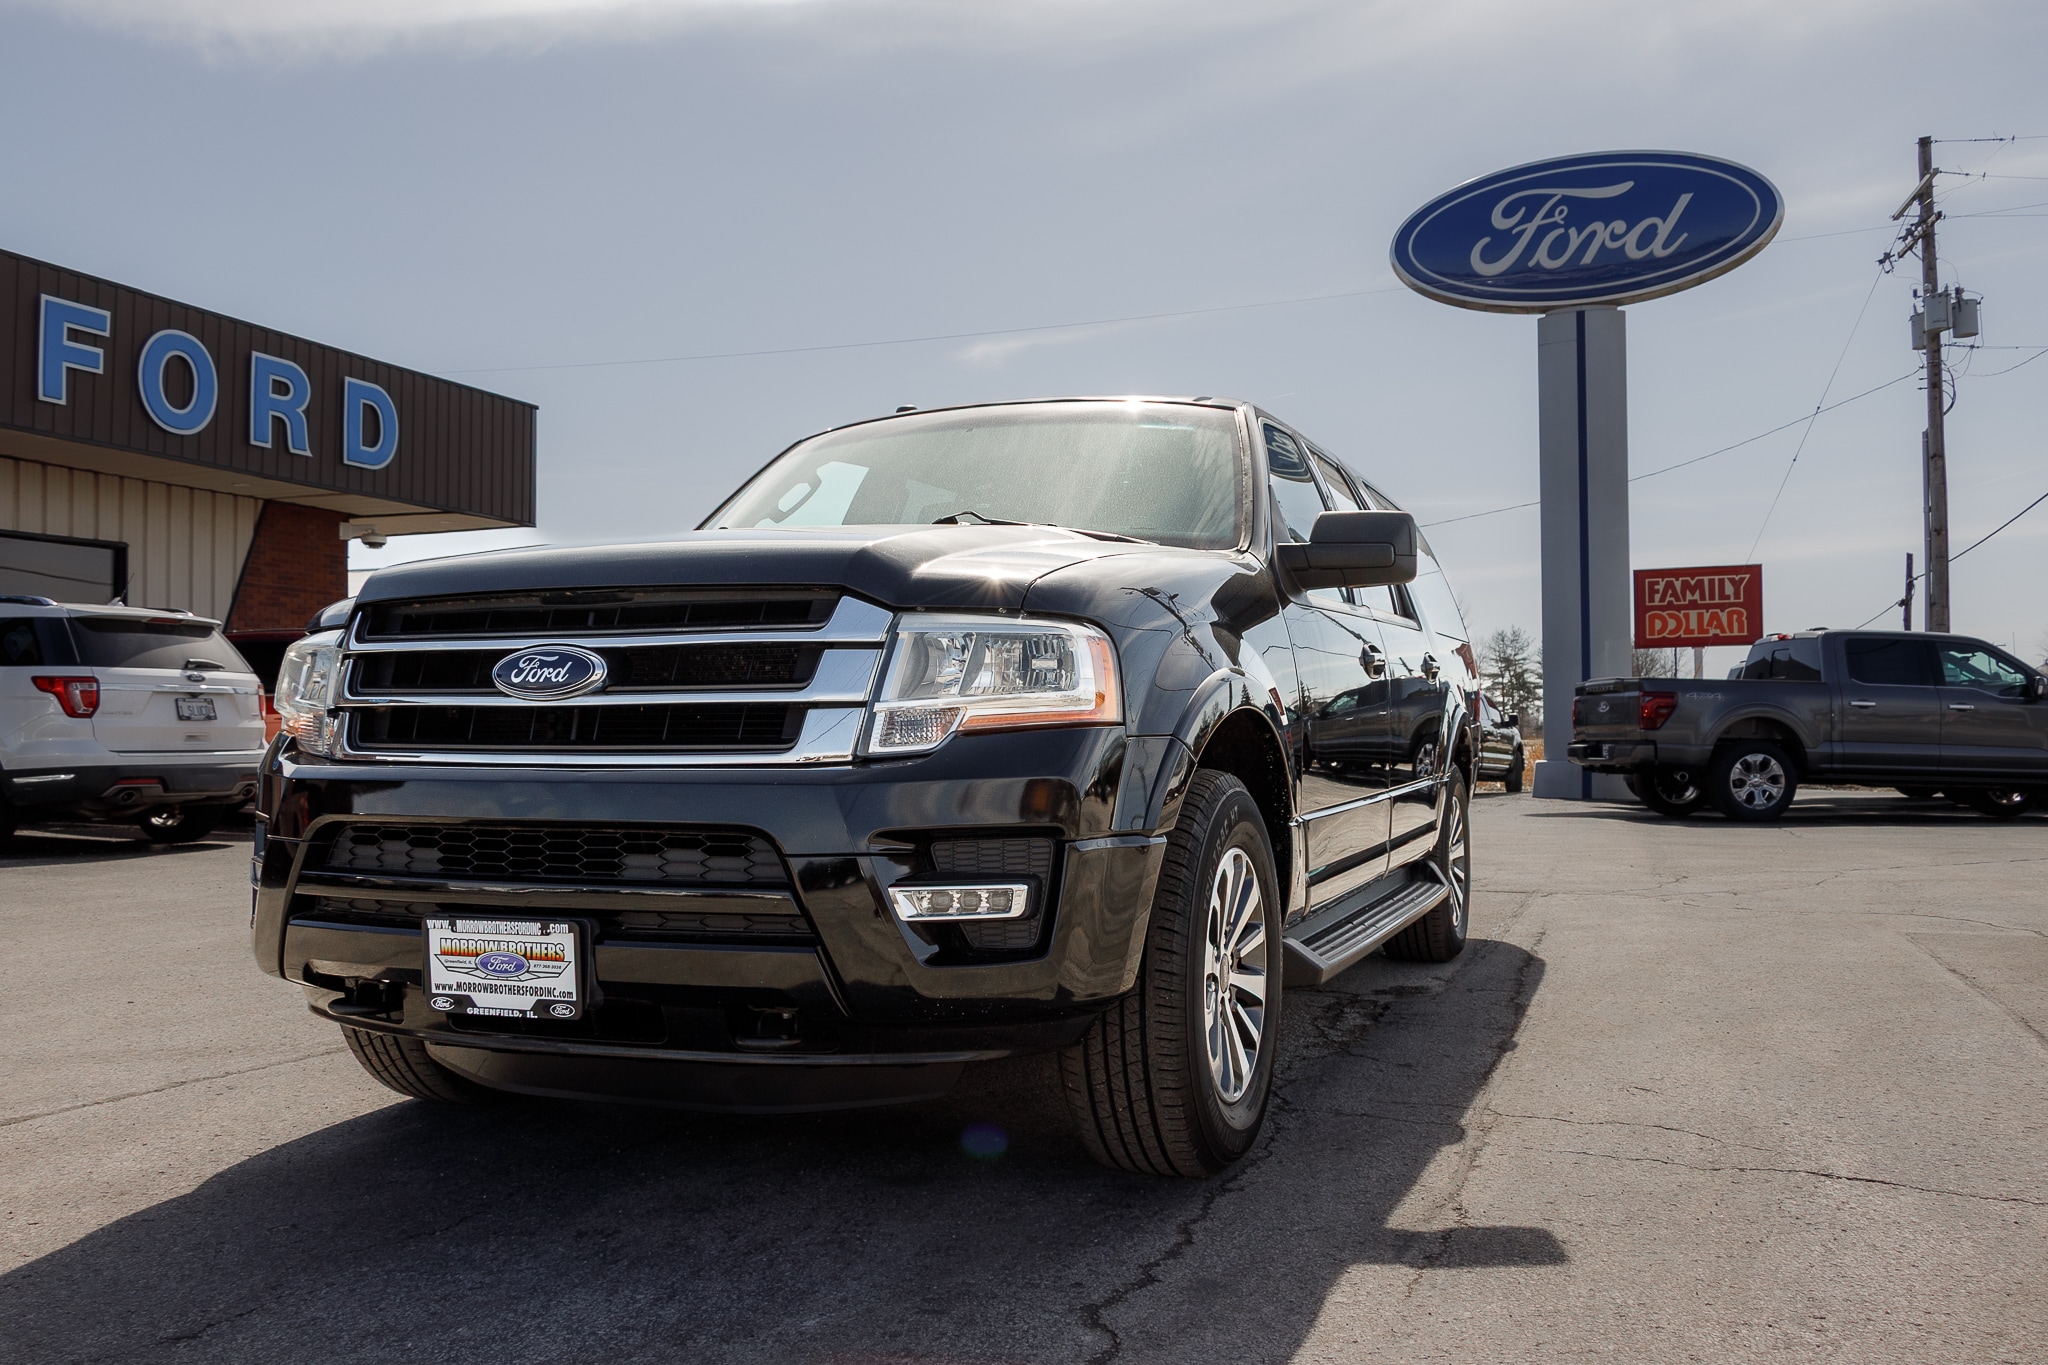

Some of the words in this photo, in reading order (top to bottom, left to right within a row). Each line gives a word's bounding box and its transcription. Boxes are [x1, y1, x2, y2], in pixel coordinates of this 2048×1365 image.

[1470, 180, 1694, 277] Ford
[38, 293, 400, 470] FORD
[1645, 574, 1751, 606] FAMILY
[1645, 607, 1748, 639] DOLLAR
[511, 655, 573, 683] Ford
[440, 938, 499, 957] MORROW
[500, 940, 565, 962] BROTHERS
[488, 955, 517, 972] Ford
[434, 981, 574, 999] www.MORROWBROTHERSFORDINC.com
[435, 998, 451, 1008] Ford
[466, 1007, 523, 1018] GREENFIELD,
[554, 1005, 571, 1015] Ford
